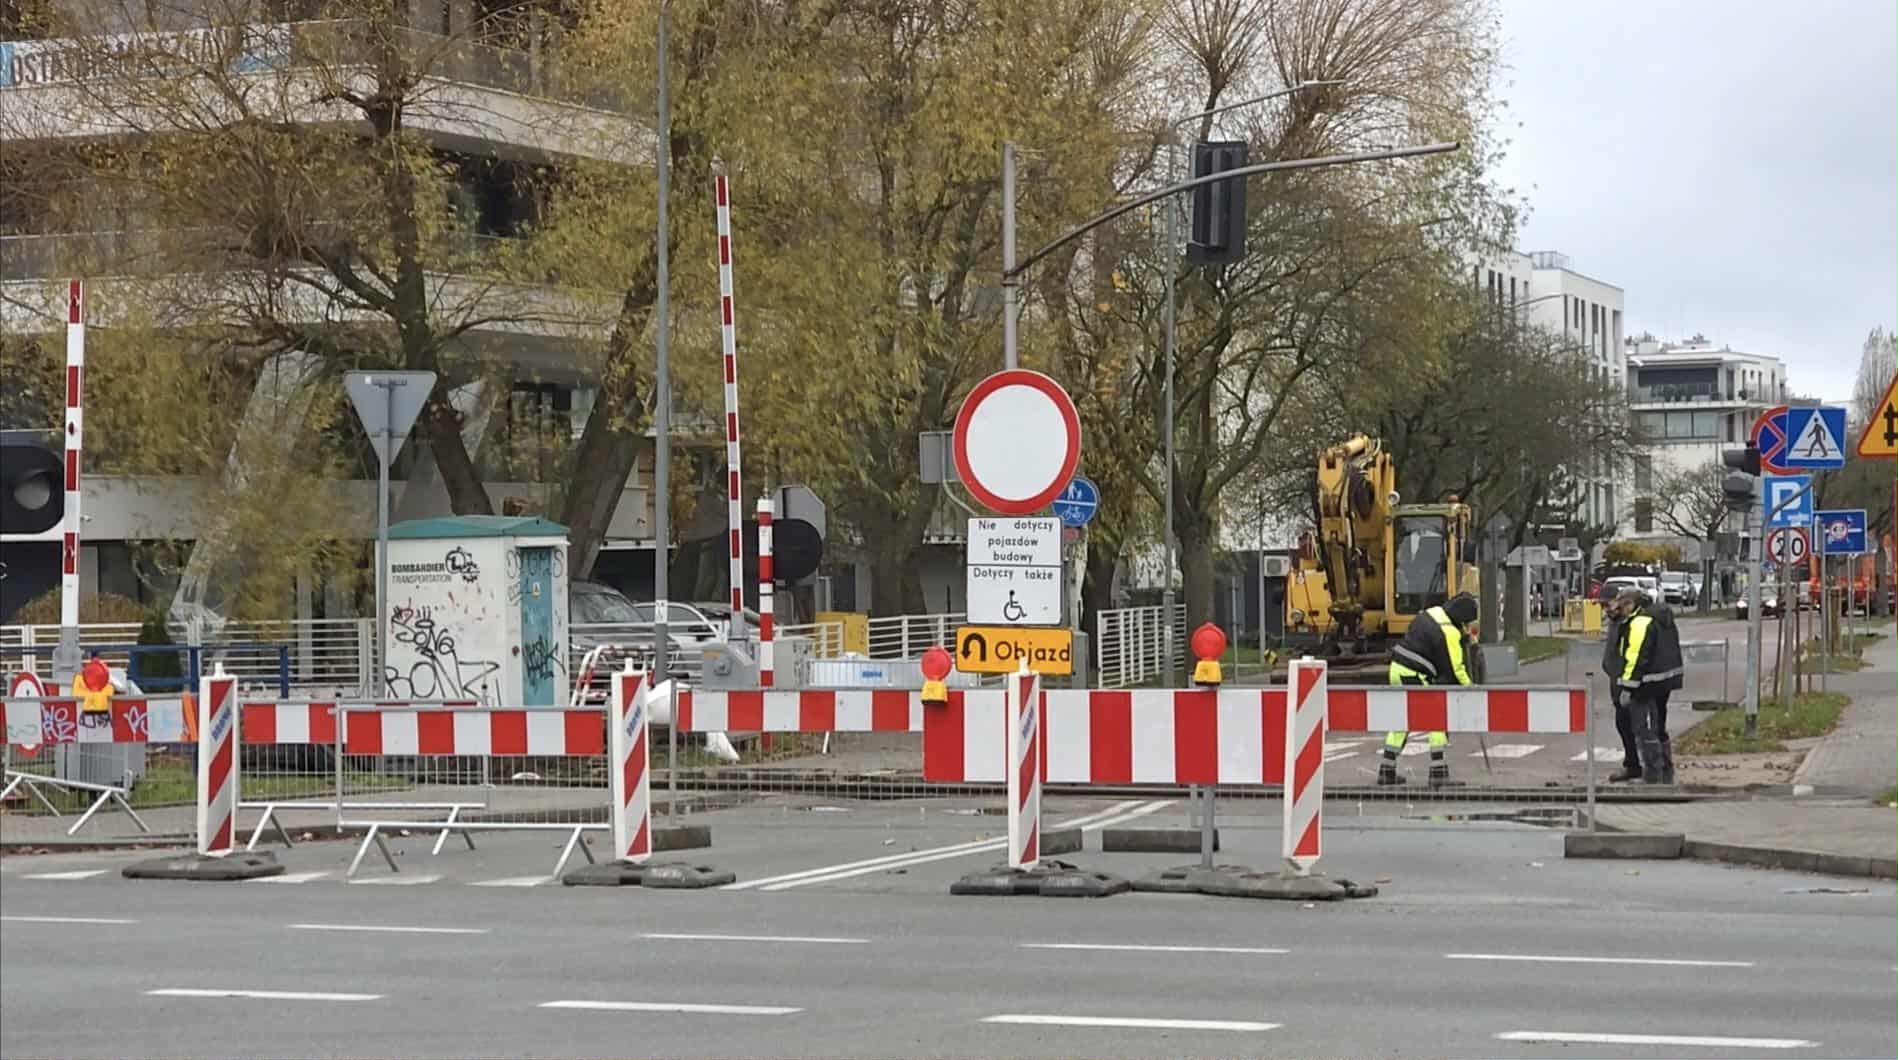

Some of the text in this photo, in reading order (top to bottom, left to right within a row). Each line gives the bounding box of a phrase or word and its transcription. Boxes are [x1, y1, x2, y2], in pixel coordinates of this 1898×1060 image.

[1771, 481, 1802, 521] P
[978, 520, 1054, 532] Nie dotyczy
[988, 536, 1039, 548] pojazdów
[1775, 537, 1804, 557] 20
[993, 551, 1033, 563] budowy
[392, 574, 452, 584] TRANSPORTATION
[973, 567, 1054, 581] Dotyczy także
[994, 640, 1070, 665] Objazd
